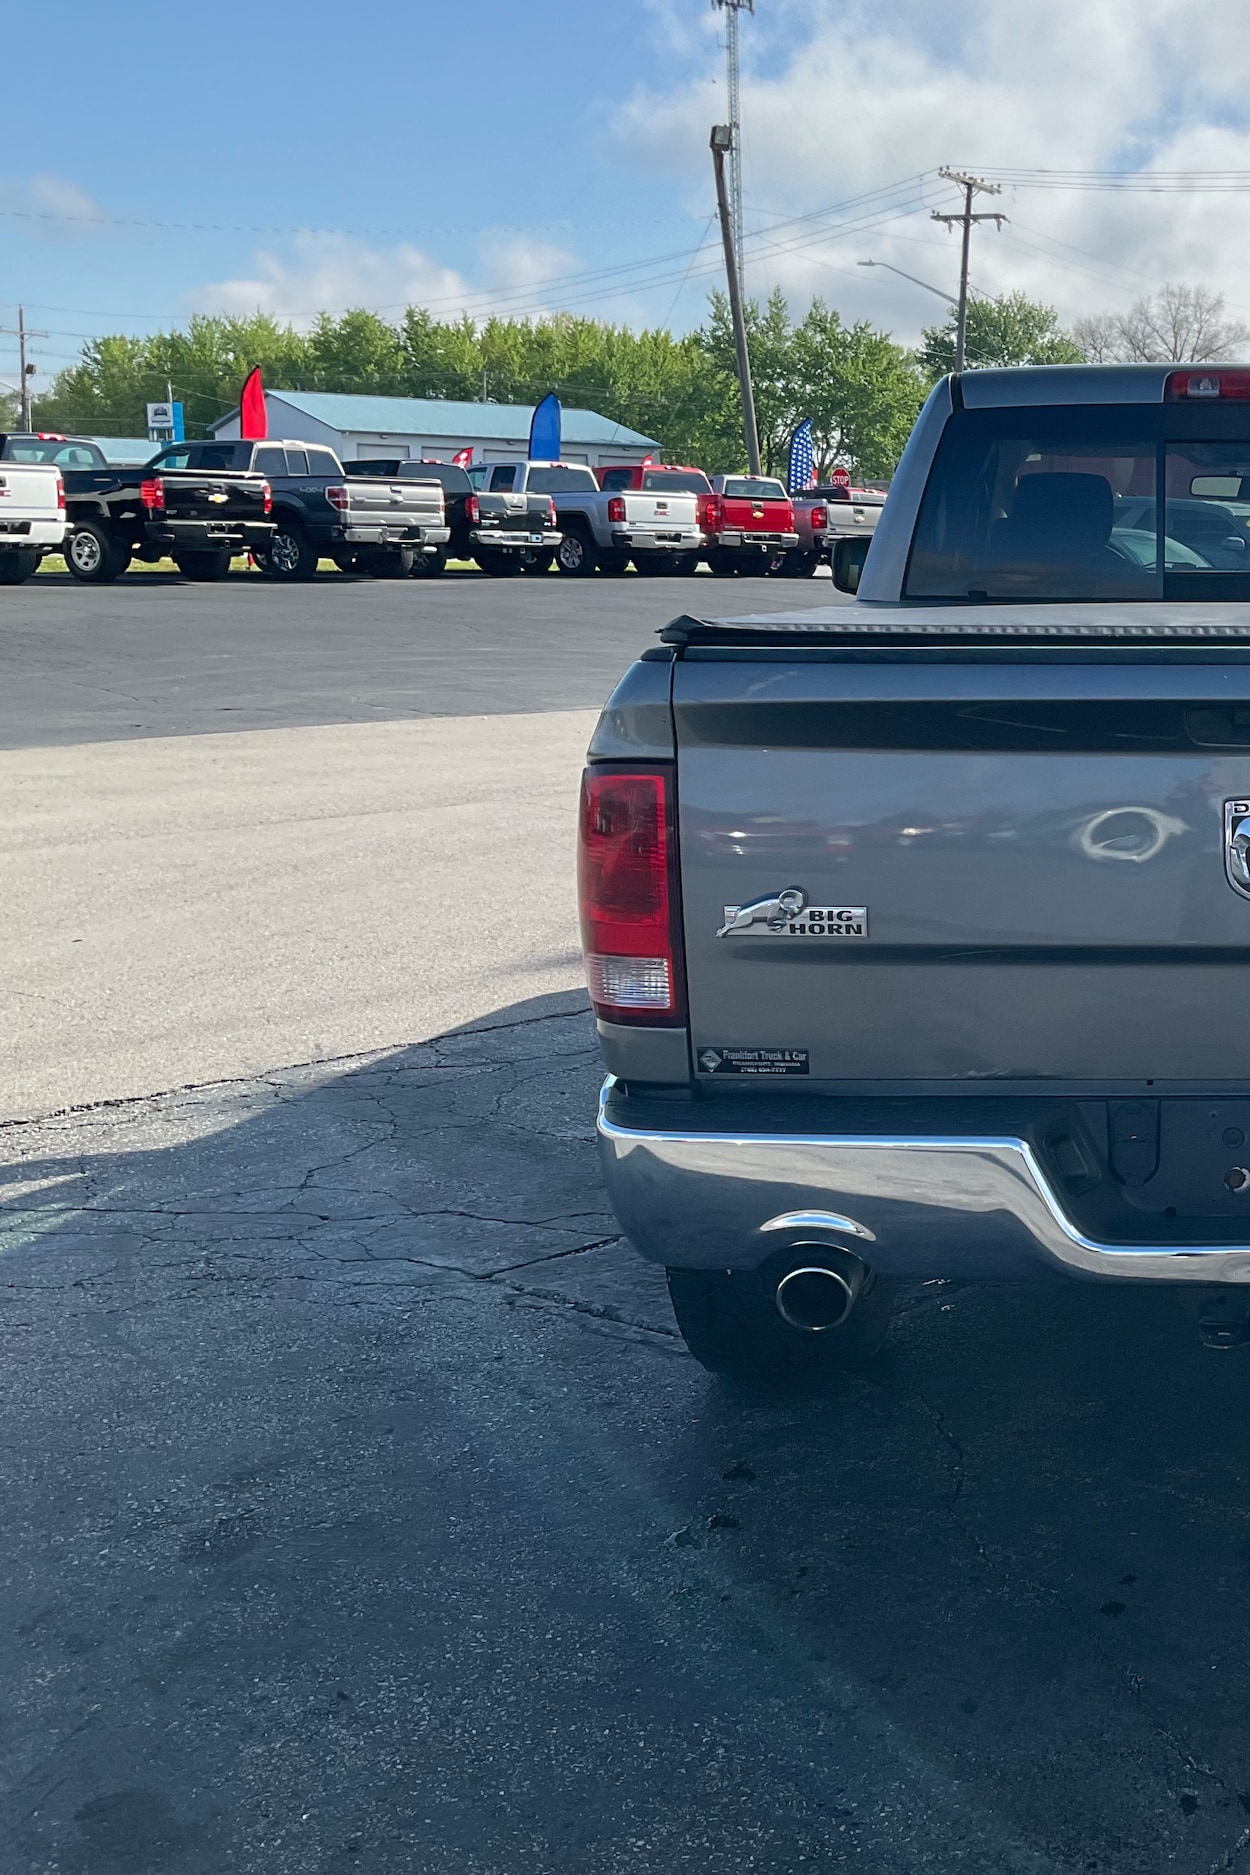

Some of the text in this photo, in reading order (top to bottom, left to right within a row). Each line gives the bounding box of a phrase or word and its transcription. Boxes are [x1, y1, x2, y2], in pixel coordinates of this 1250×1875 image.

[832, 475, 849, 485] STOP
[809, 910, 853, 922] BIG
[789, 923, 863, 935] HORN
[722, 1049, 807, 1061] Frankfort Truck & Car
